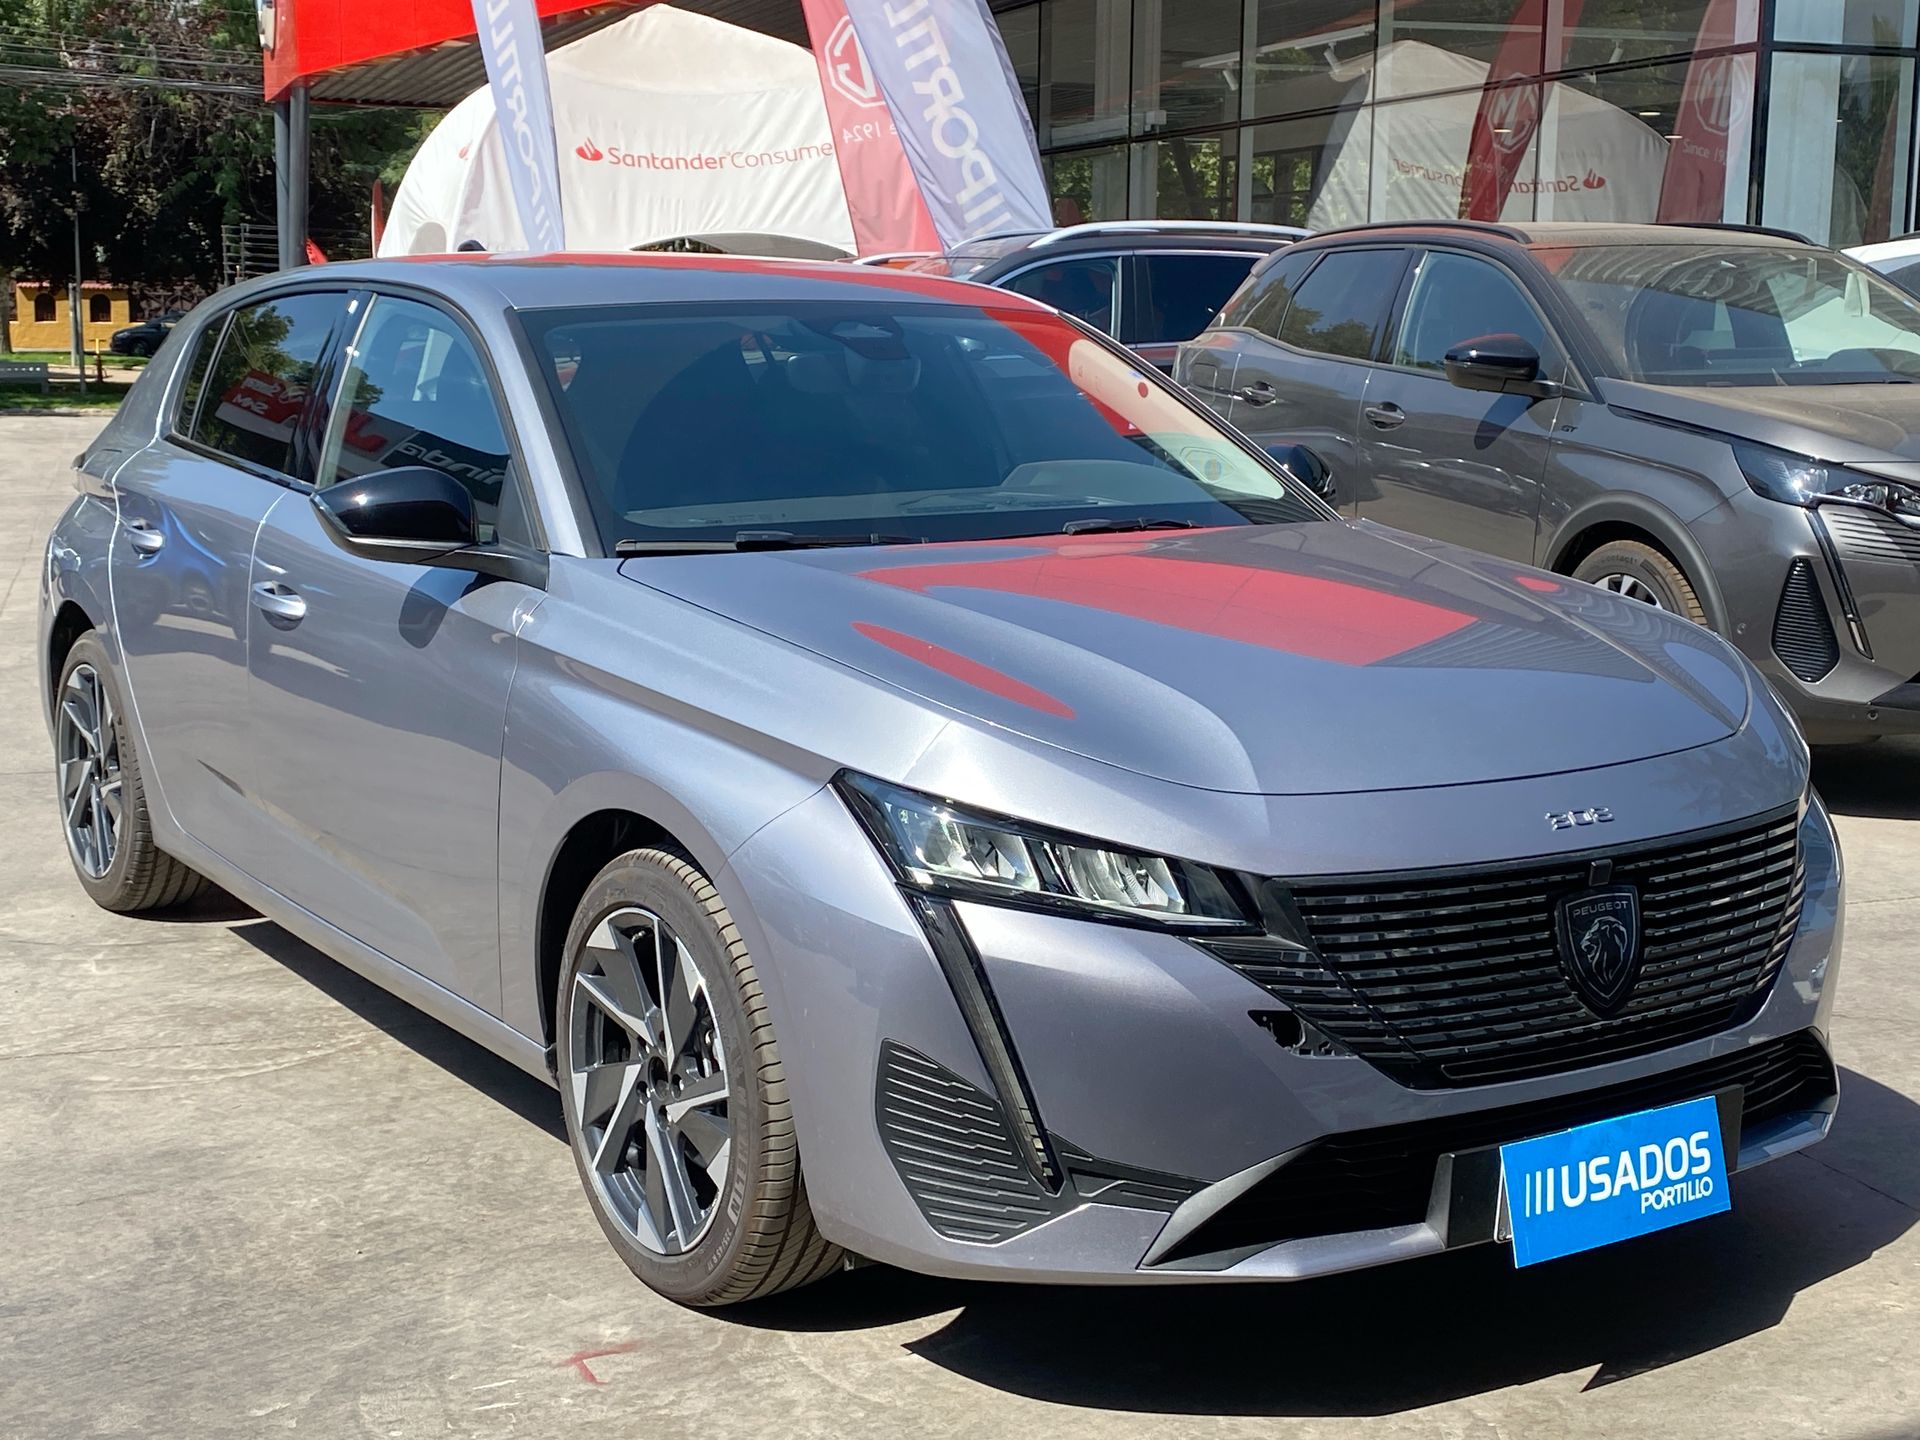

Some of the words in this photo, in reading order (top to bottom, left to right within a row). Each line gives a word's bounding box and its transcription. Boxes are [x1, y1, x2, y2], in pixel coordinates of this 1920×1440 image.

[608, 147, 727, 170] Santander
[730, 142, 834, 169] Consume
[1544, 806, 1616, 831] 308
[1572, 900, 1629, 918] PEUGEOT
[1561, 1130, 1712, 1207] USADOS
[1640, 1176, 1714, 1215] PORTILLO
